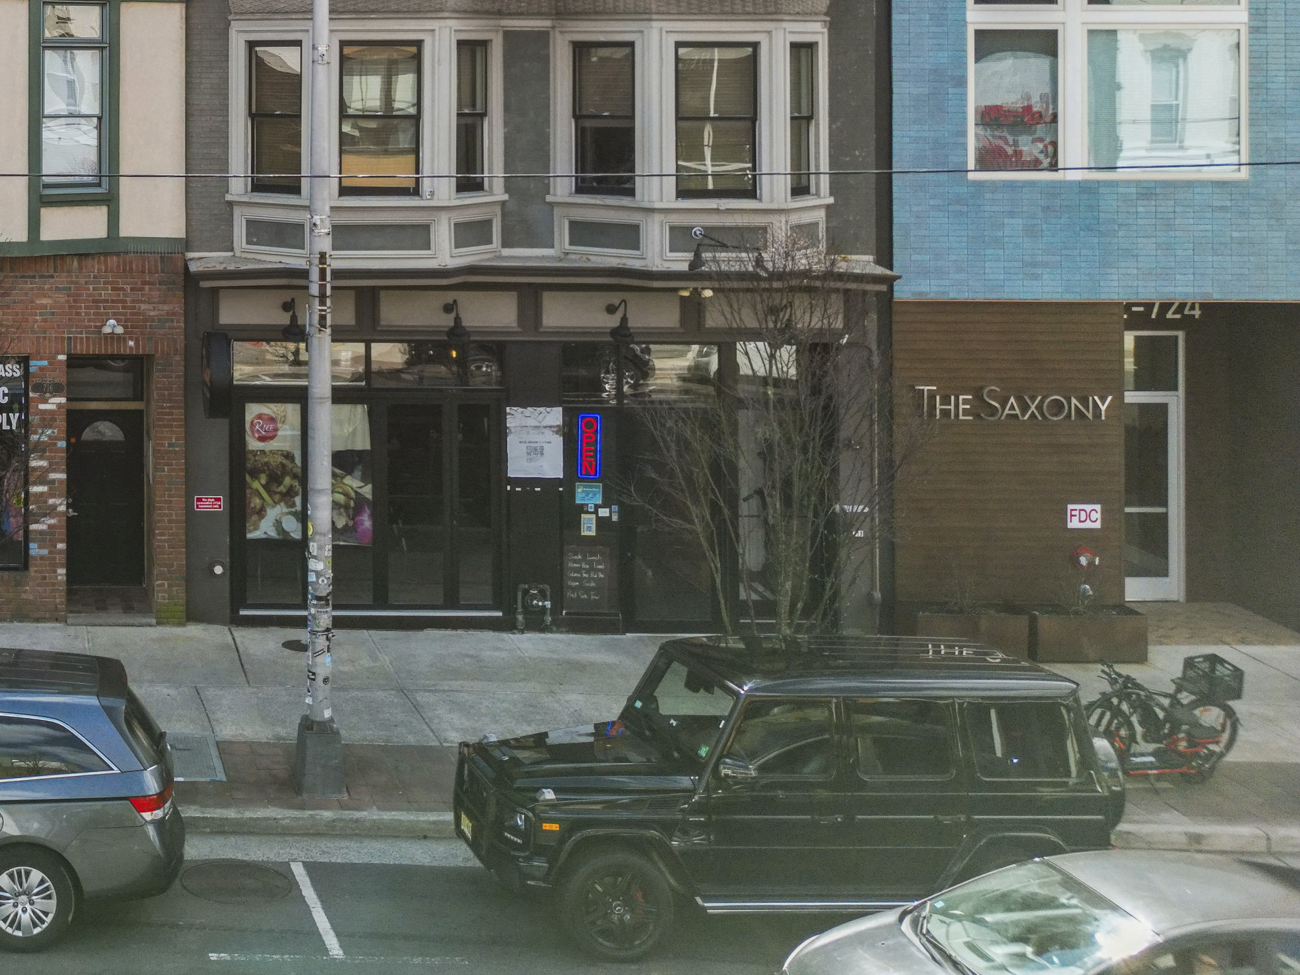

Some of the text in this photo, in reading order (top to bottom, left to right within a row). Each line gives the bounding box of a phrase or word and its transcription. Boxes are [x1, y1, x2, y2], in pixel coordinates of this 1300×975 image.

[1123, 301, 1202, 319] -724
[914, 385, 1113, 421] THE SAXONY
[581, 417, 597, 475] OPEN
[1069, 509, 1099, 523] FDC
